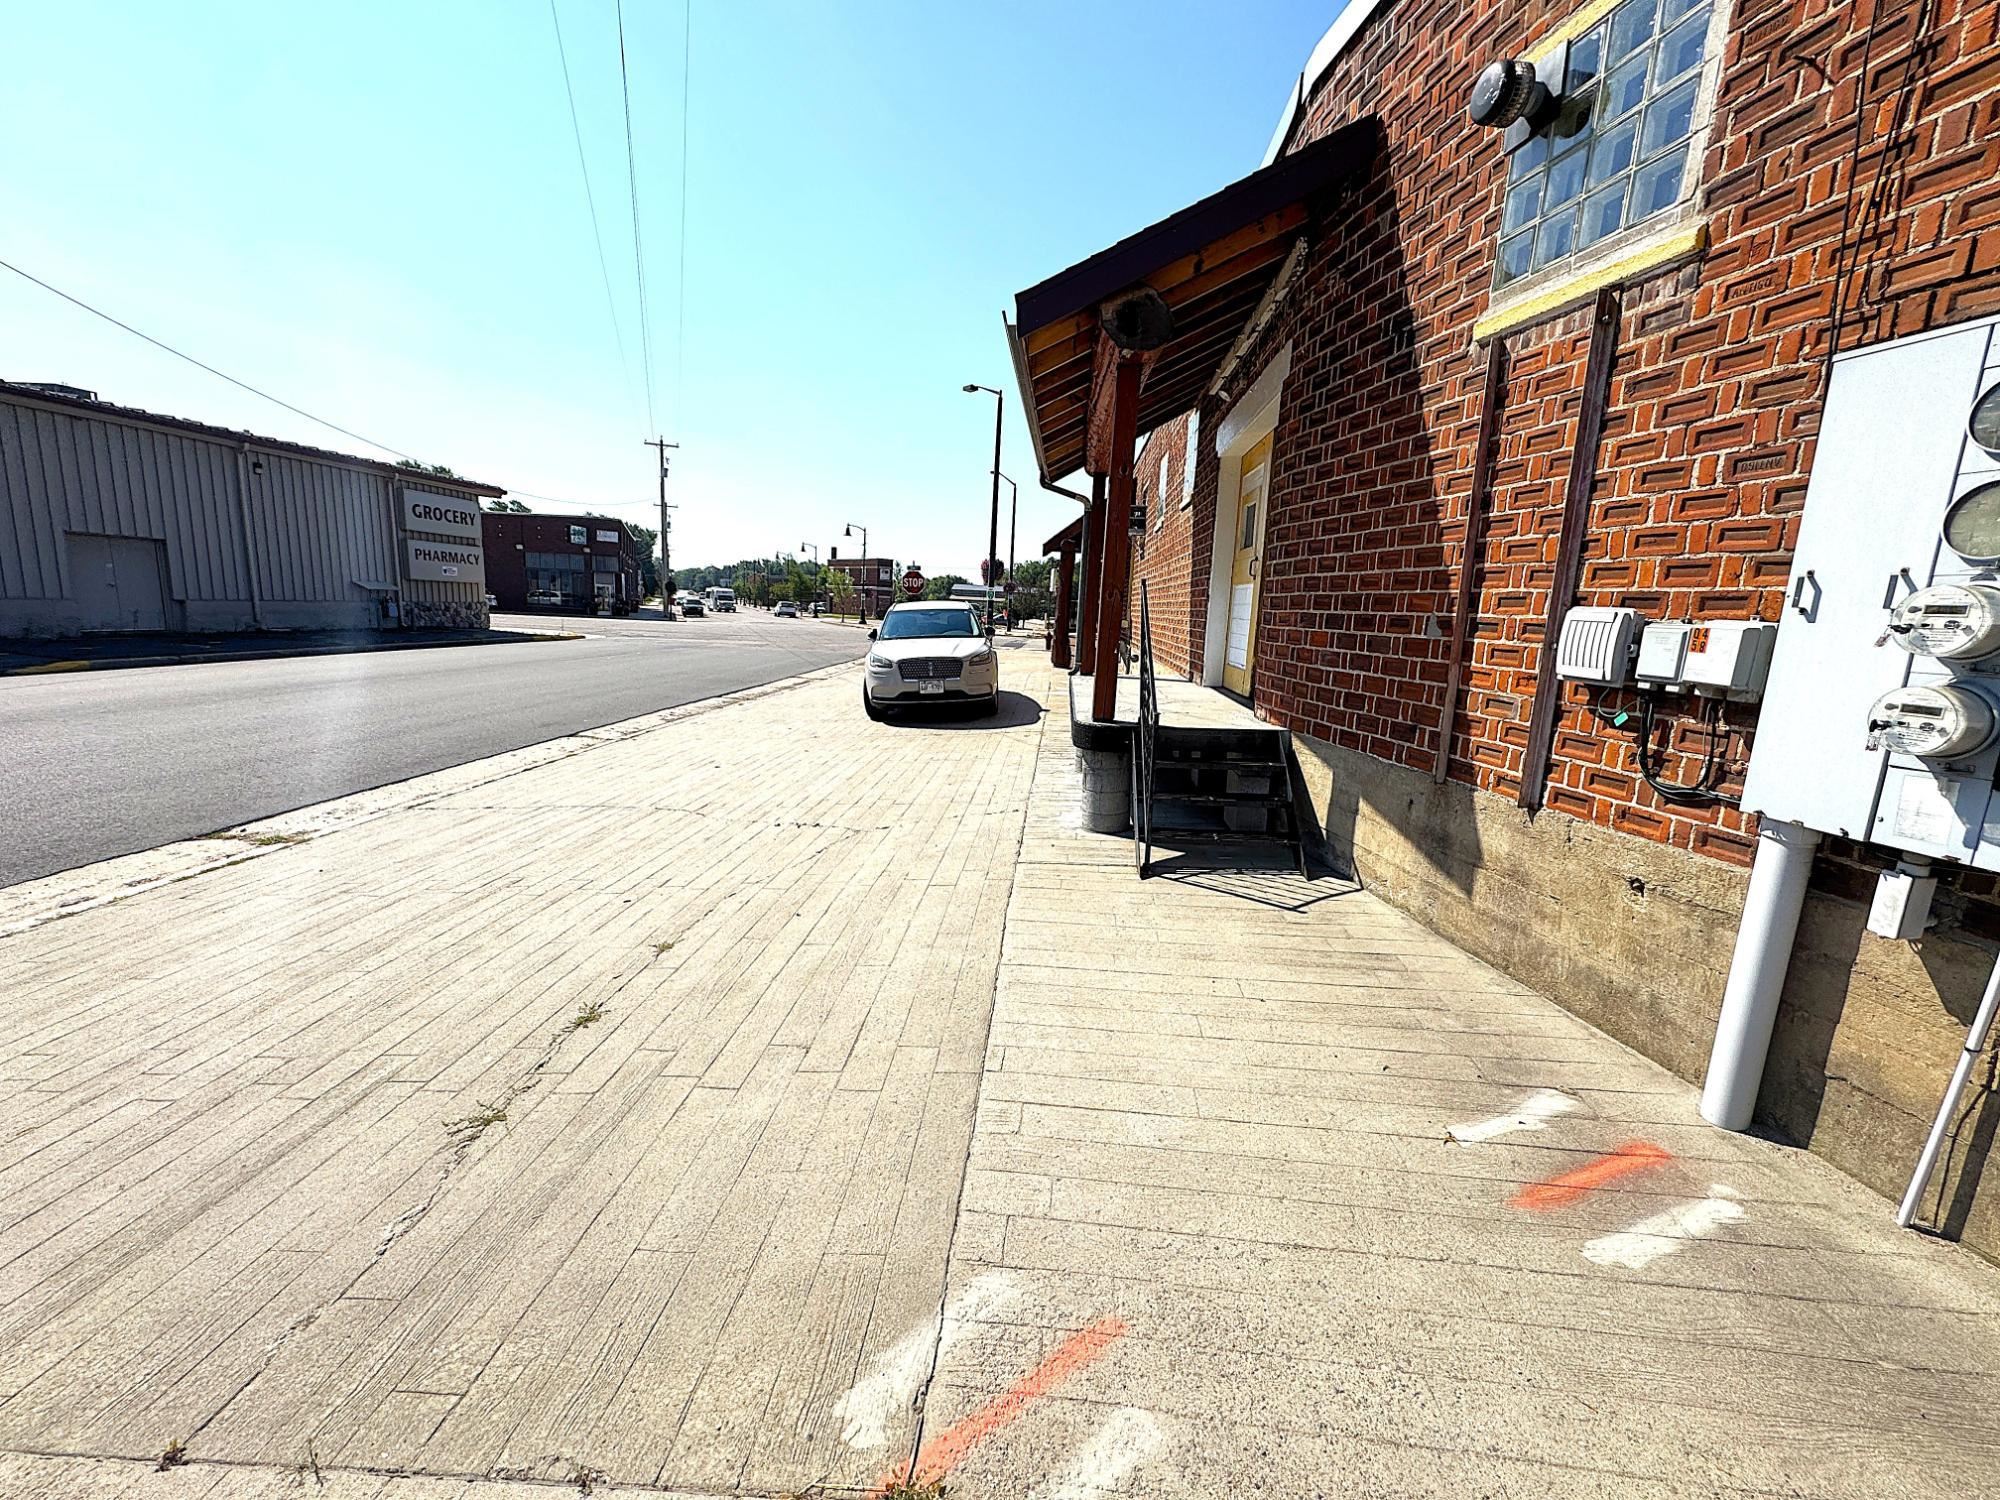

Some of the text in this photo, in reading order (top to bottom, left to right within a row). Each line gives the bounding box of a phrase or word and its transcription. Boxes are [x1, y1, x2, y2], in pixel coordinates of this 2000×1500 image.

[412, 503, 476, 526] GROCERY
[415, 548, 480, 565] PHARMACY
[903, 577, 924, 588] STOP
